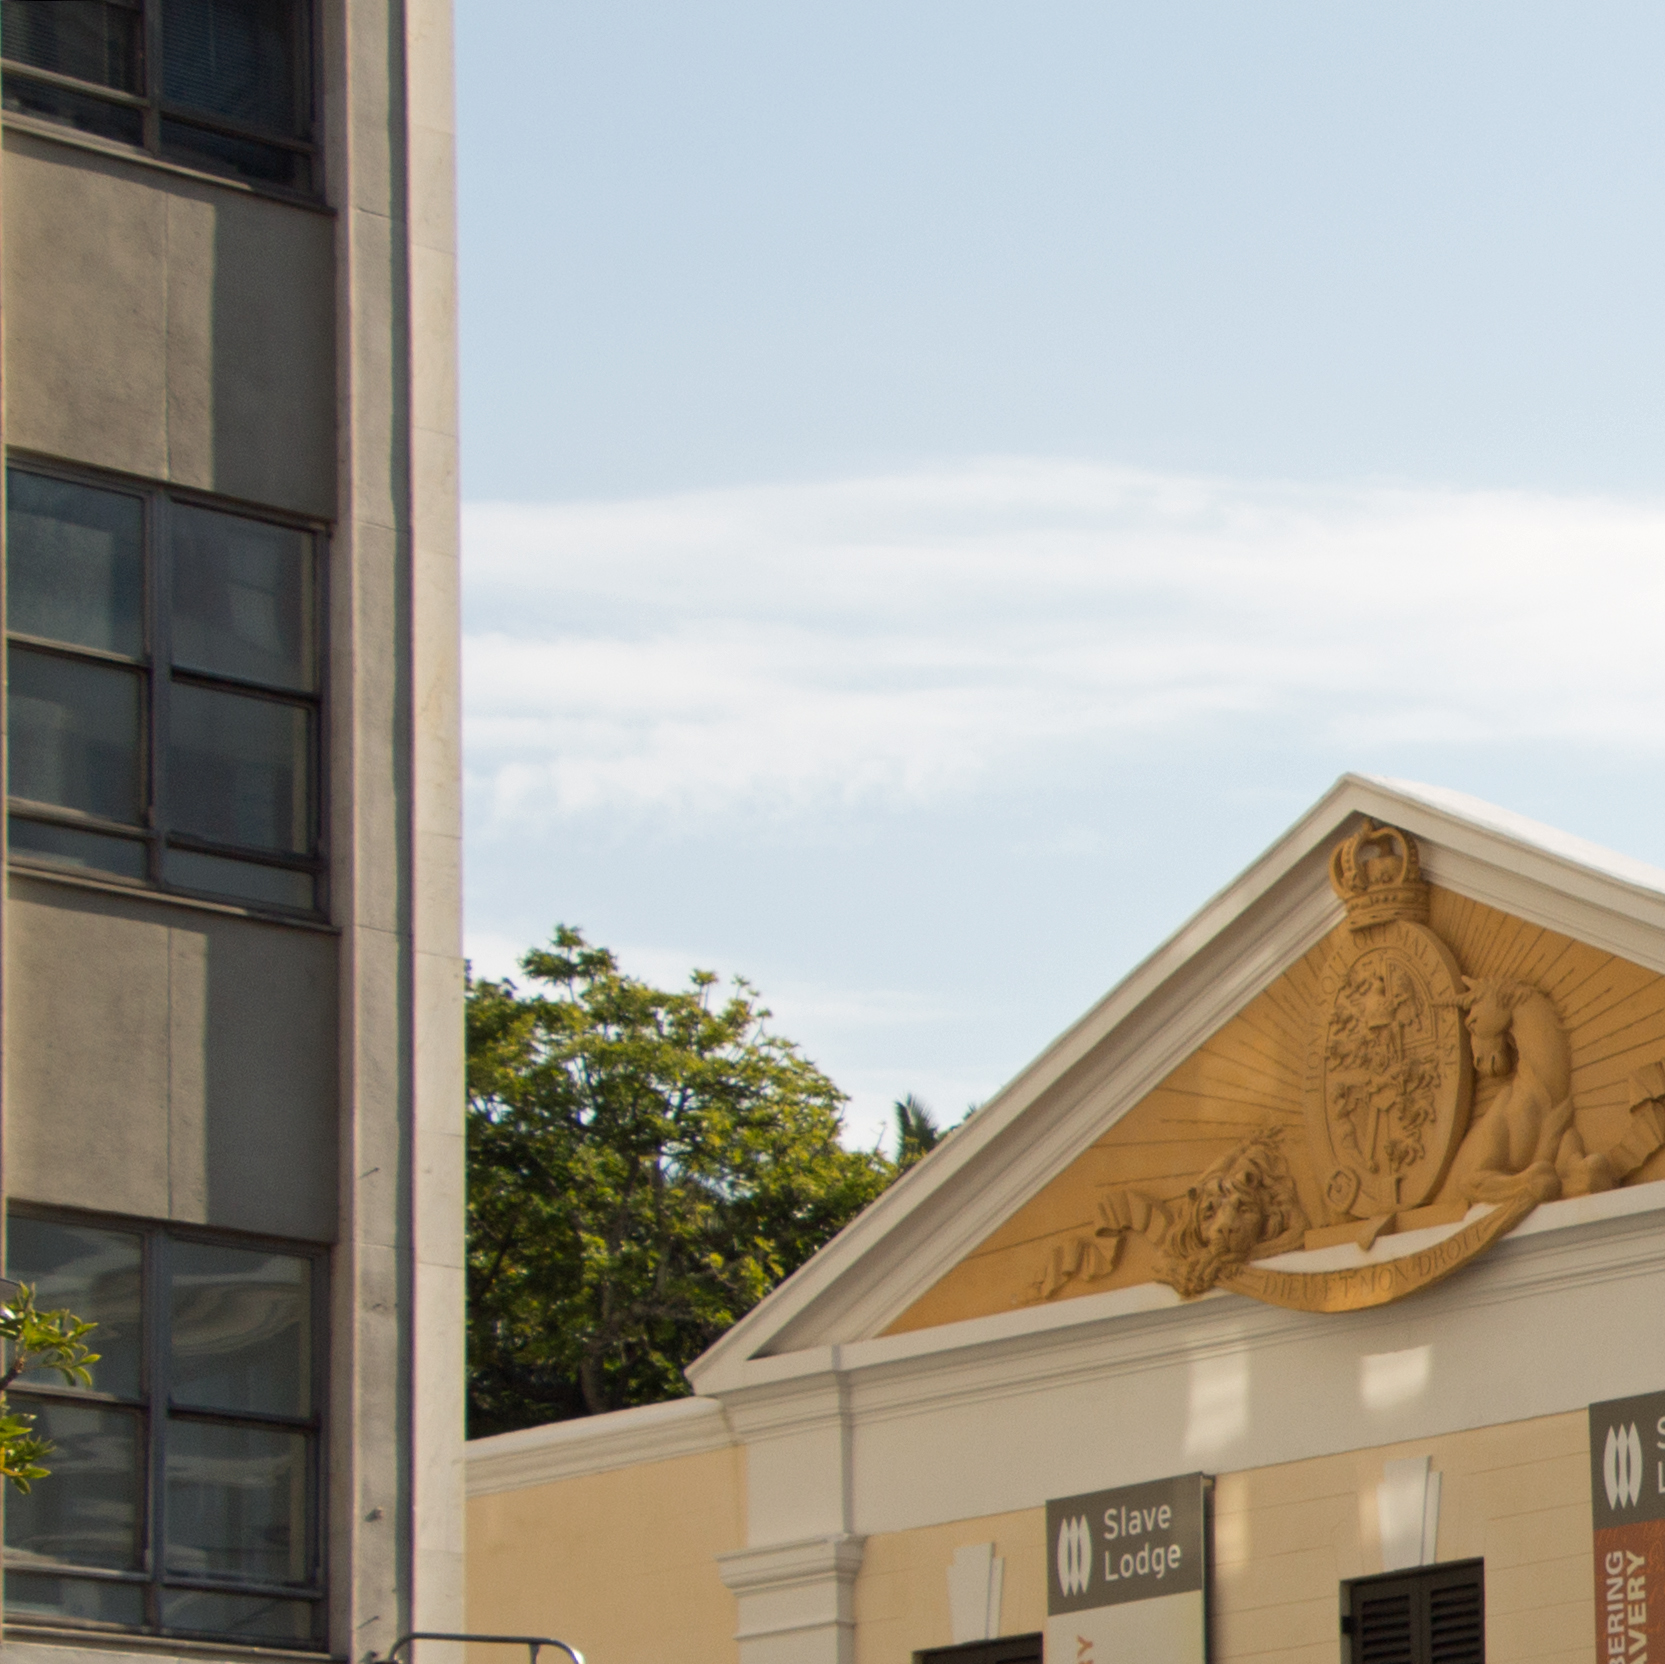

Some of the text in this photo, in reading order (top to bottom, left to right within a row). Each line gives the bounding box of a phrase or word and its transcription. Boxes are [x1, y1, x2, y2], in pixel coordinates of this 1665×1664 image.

[1418, 1226, 1482, 1278] DROIT
[1103, 1504, 1172, 1540] Slave
[1104, 1542, 1182, 1581] Lodge
